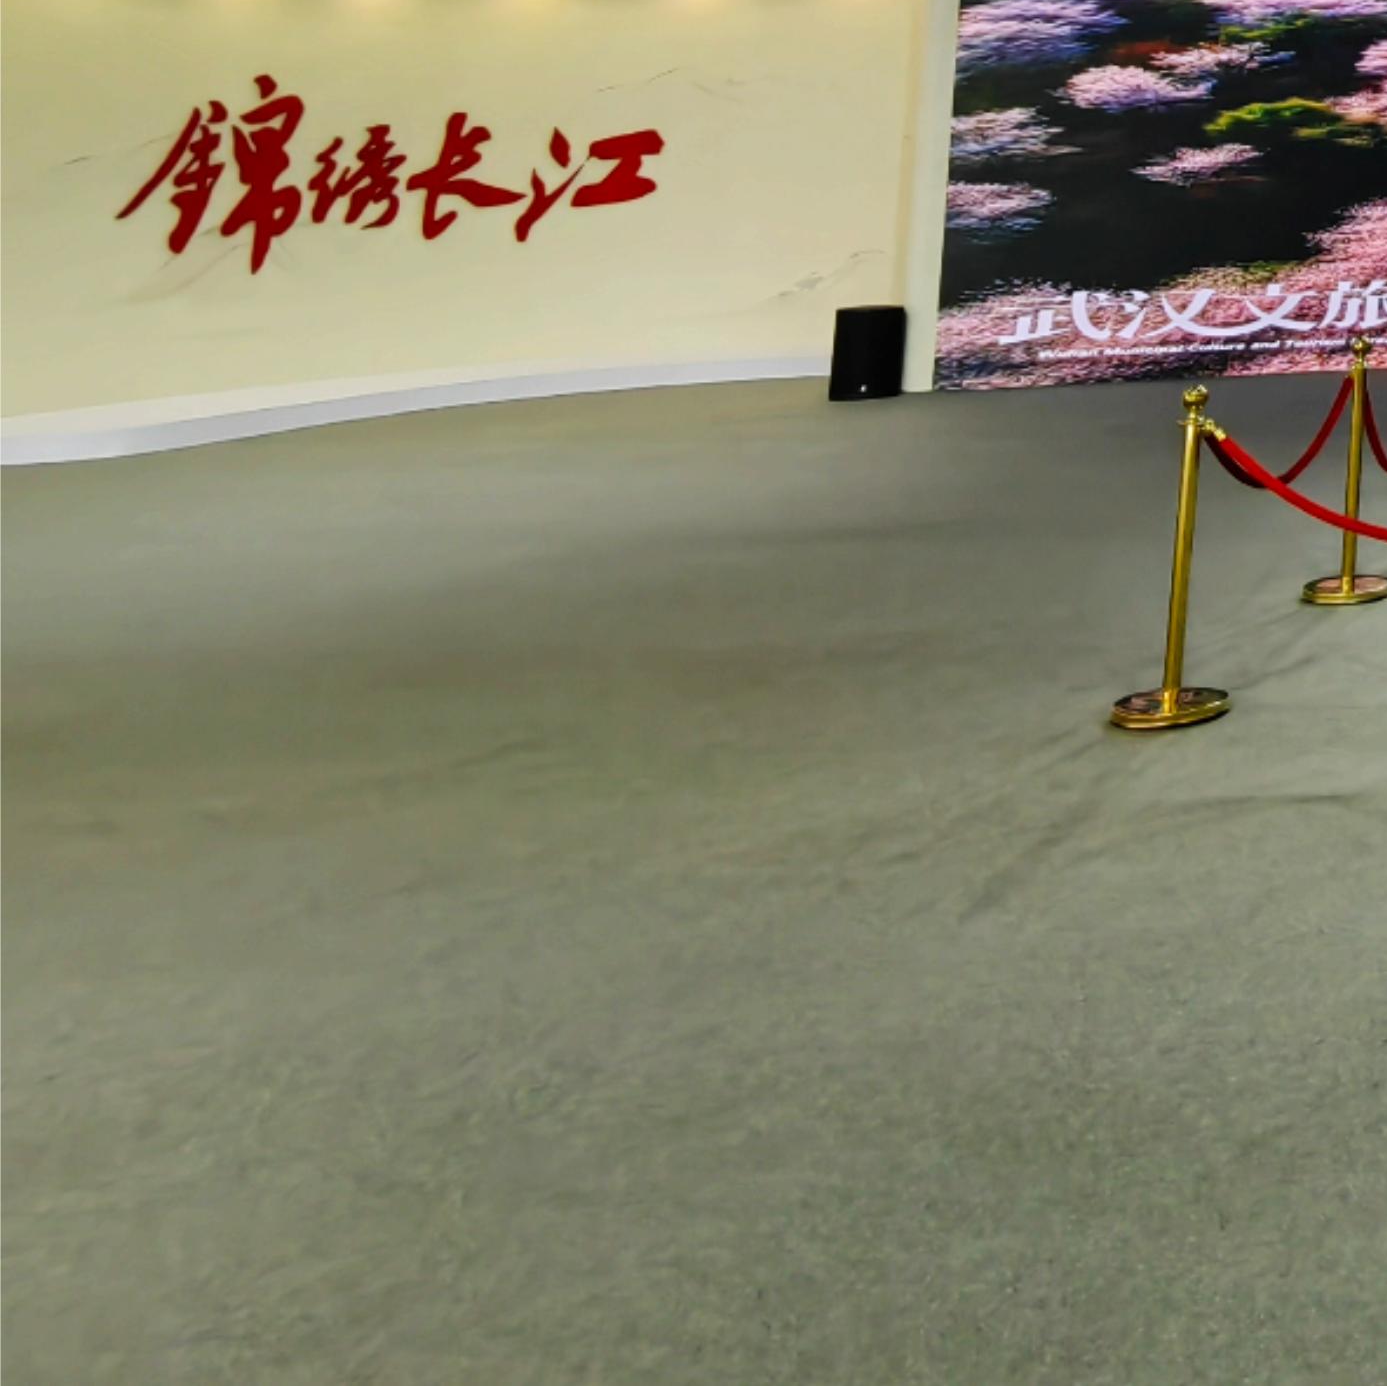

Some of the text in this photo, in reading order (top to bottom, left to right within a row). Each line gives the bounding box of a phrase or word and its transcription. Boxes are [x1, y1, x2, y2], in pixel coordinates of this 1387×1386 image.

[1038, 347, 1100, 359] Wuhan
[1103, 344, 1184, 356] Municipal
[1187, 341, 1246, 353] Culture
[1251, 339, 1281, 350] and
[1286, 337, 1346, 349] Tourism
